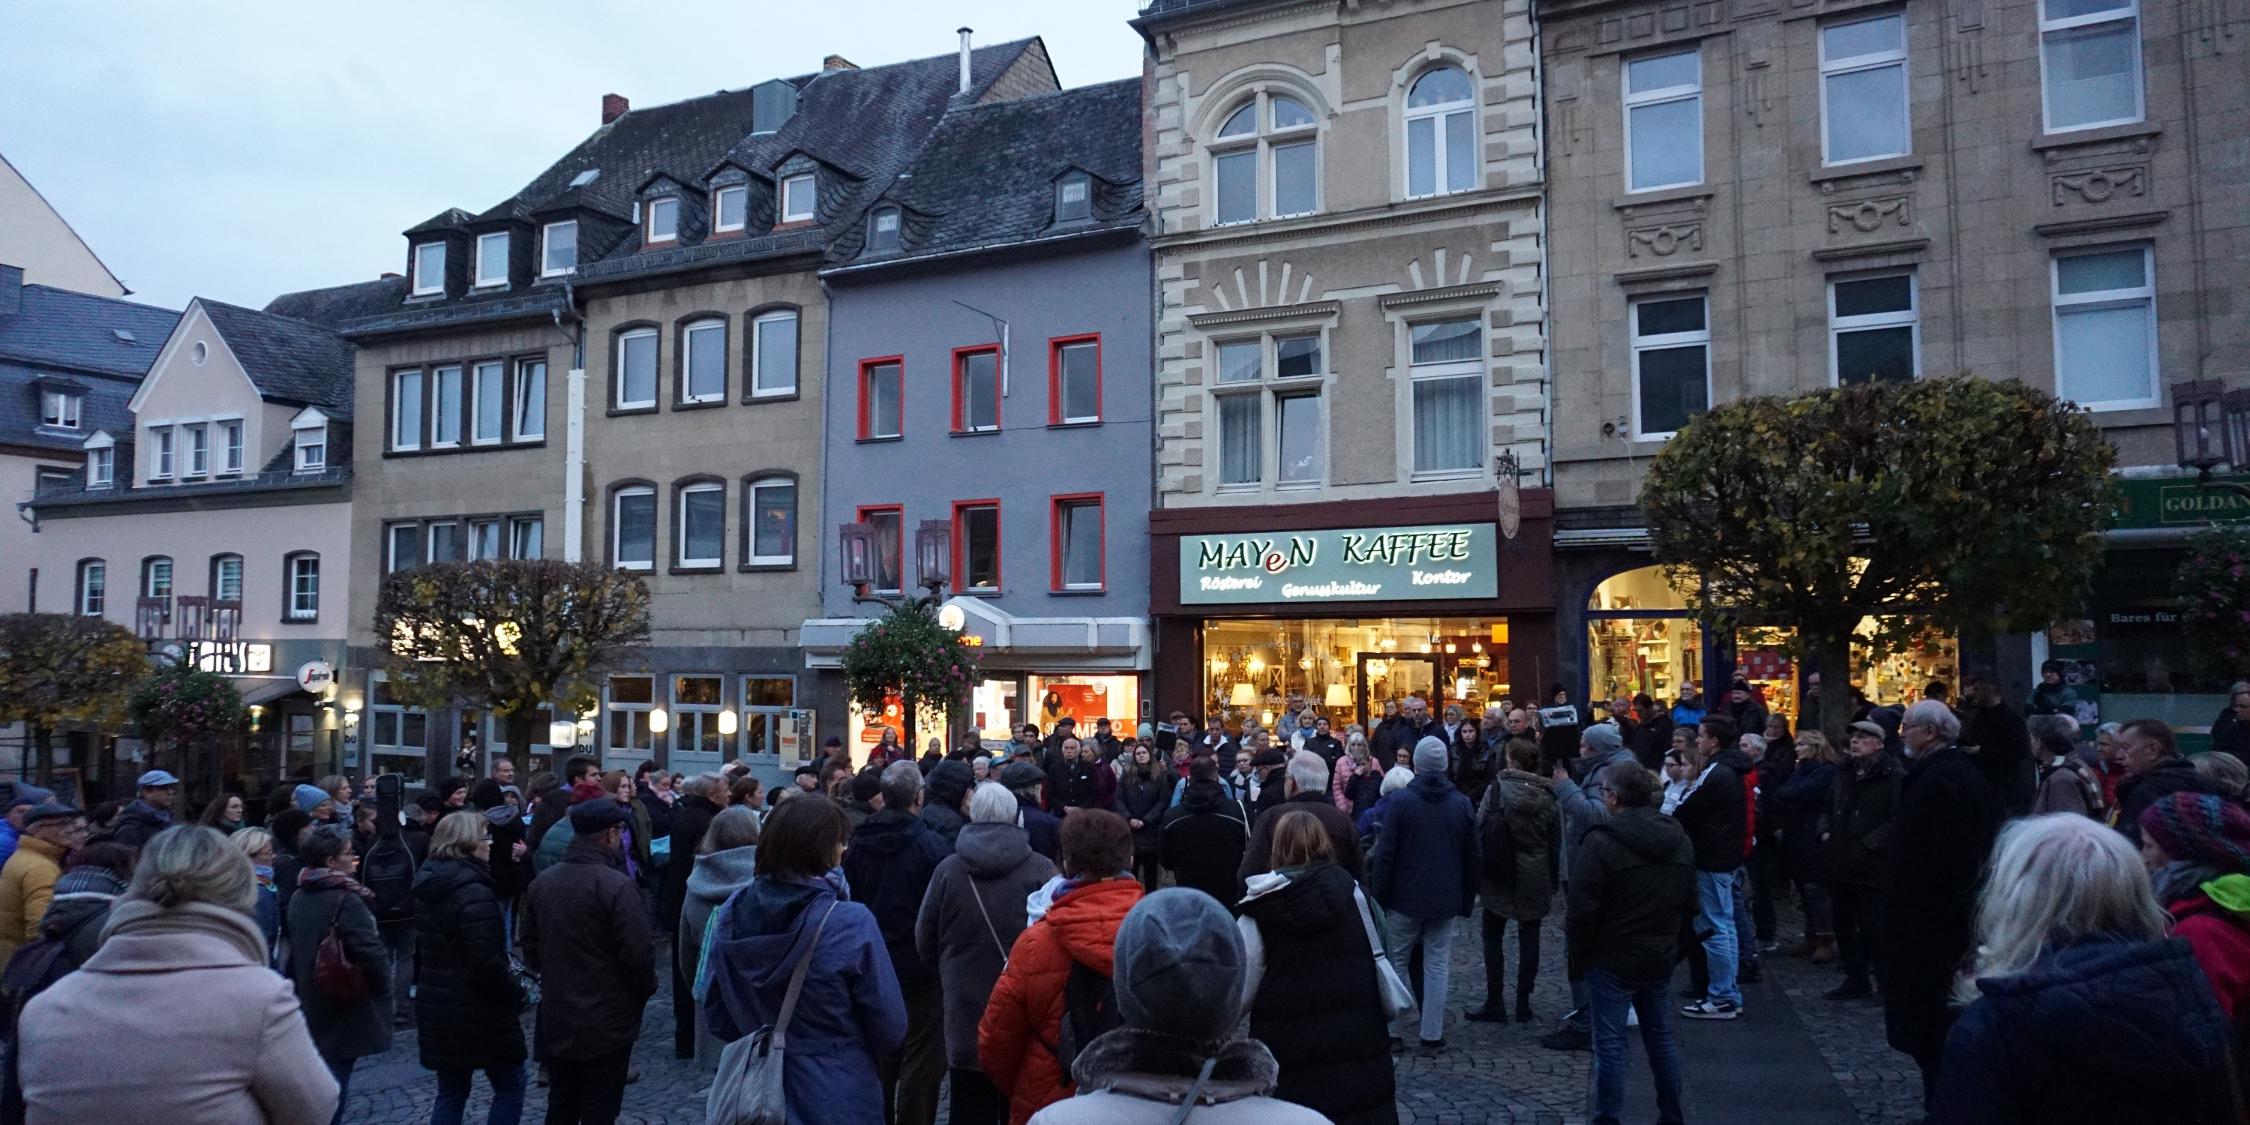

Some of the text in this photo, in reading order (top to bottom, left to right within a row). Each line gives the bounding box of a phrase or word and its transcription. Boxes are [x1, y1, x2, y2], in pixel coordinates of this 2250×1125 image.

[1198, 530, 1472, 573] MAYeN KAFFEE
[1200, 576, 1262, 591] Rösterei
[1411, 569, 1472, 585] Kontor
[1281, 581, 1382, 598] Genusskultur
[2110, 611, 2177, 623] Bares für
[579, 744, 592, 753] DU
